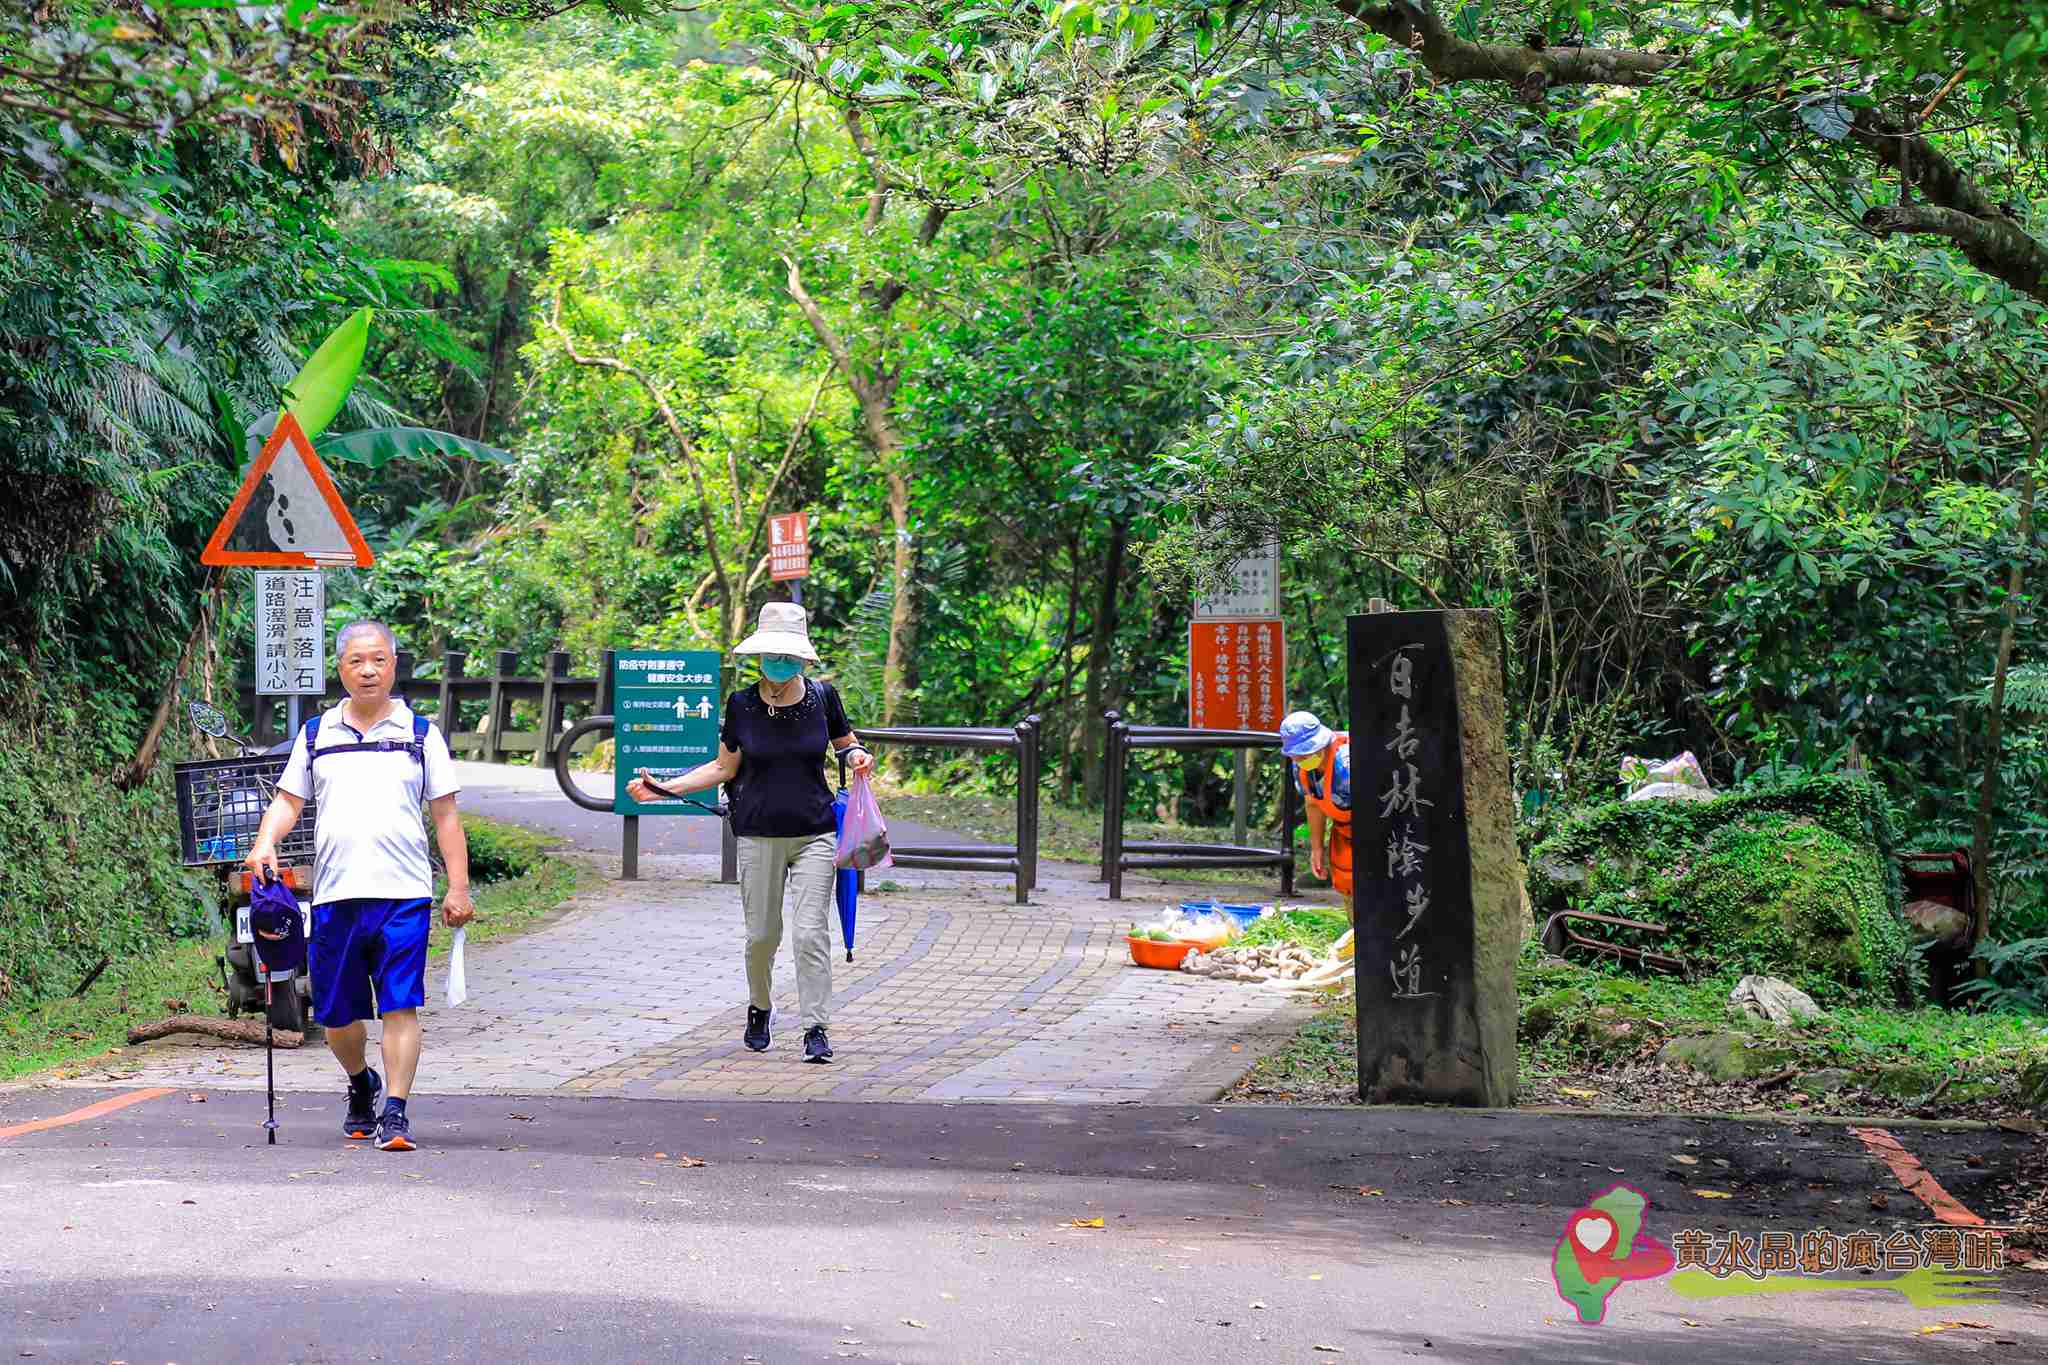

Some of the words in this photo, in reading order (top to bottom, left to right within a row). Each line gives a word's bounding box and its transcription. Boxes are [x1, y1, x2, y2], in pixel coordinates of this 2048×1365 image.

[293, 577, 315, 689] 注意落石
[1371, 643, 1440, 998] 百吉林蔭步道
